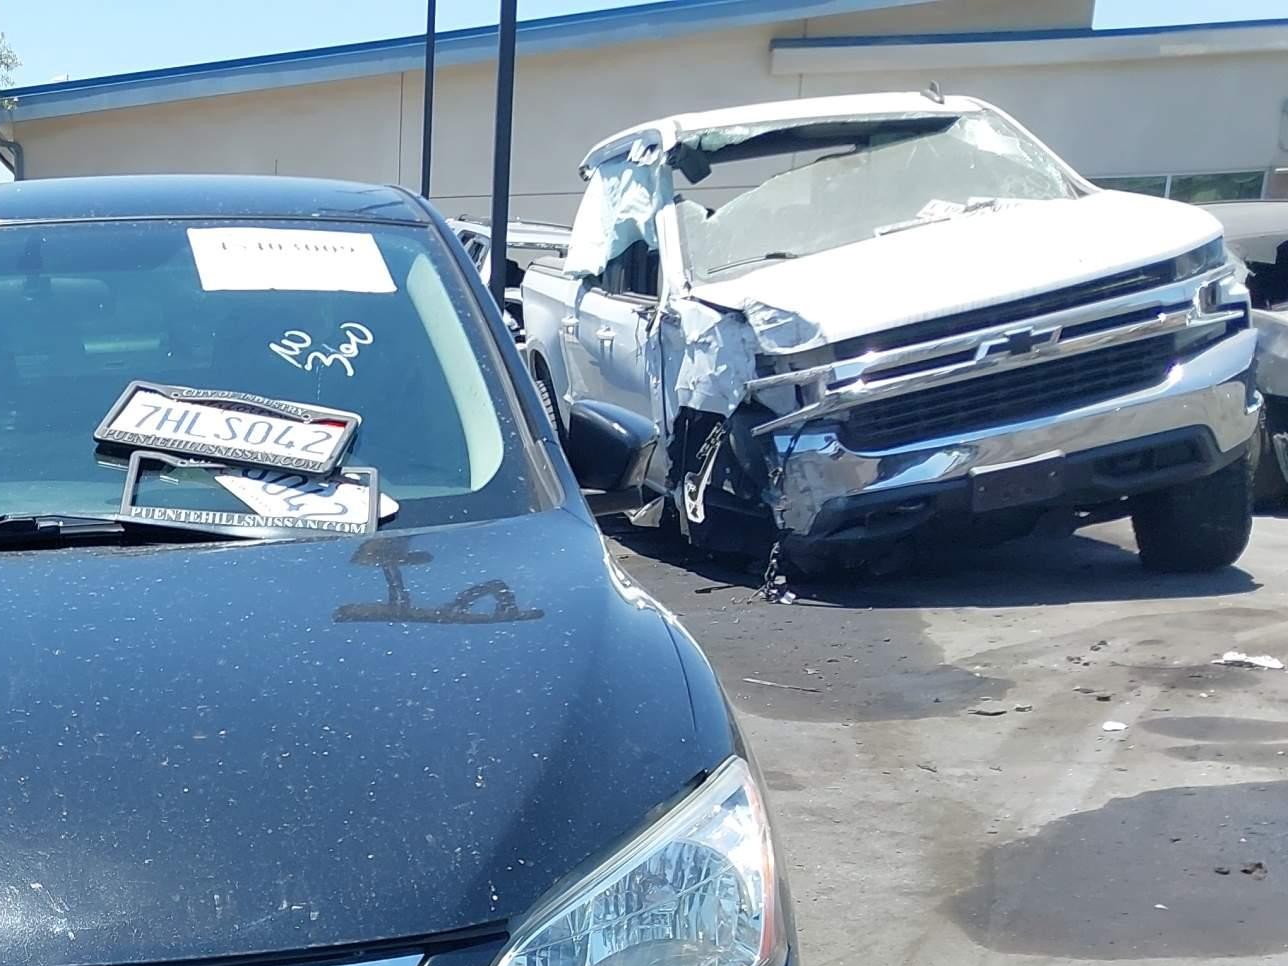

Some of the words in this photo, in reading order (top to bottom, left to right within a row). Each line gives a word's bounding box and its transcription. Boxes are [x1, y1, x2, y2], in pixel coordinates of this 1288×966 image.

[182, 387, 216, 399] CITY
[240, 393, 308, 417] INDUSTRY
[134, 403, 333, 455] 7HLS042
